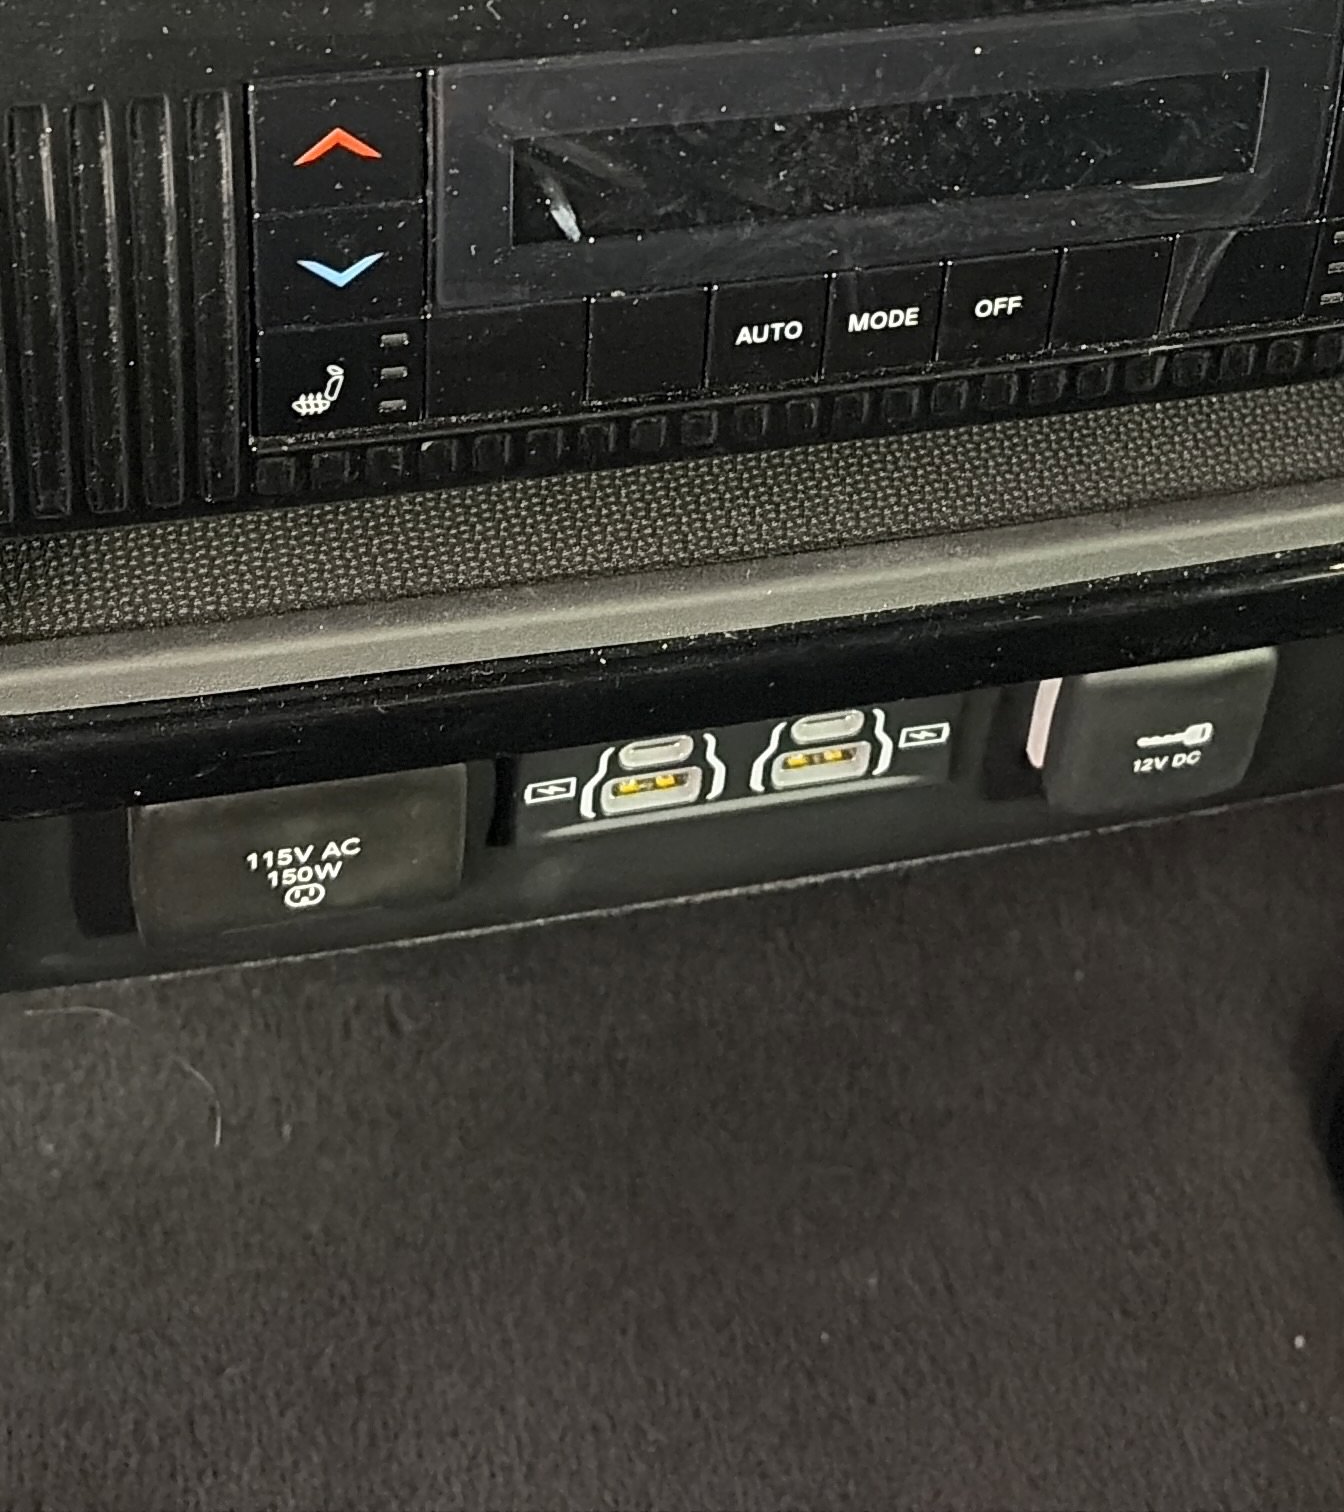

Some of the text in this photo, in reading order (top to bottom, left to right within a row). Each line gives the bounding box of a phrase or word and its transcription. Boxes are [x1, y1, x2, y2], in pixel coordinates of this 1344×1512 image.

[846, 306, 921, 333] MODE
[973, 295, 1024, 318] OFF
[734, 320, 804, 346] AUTO
[1132, 749, 1202, 774] 12V DC
[245, 836, 362, 872] 115V AC
[266, 860, 344, 889] 150W
